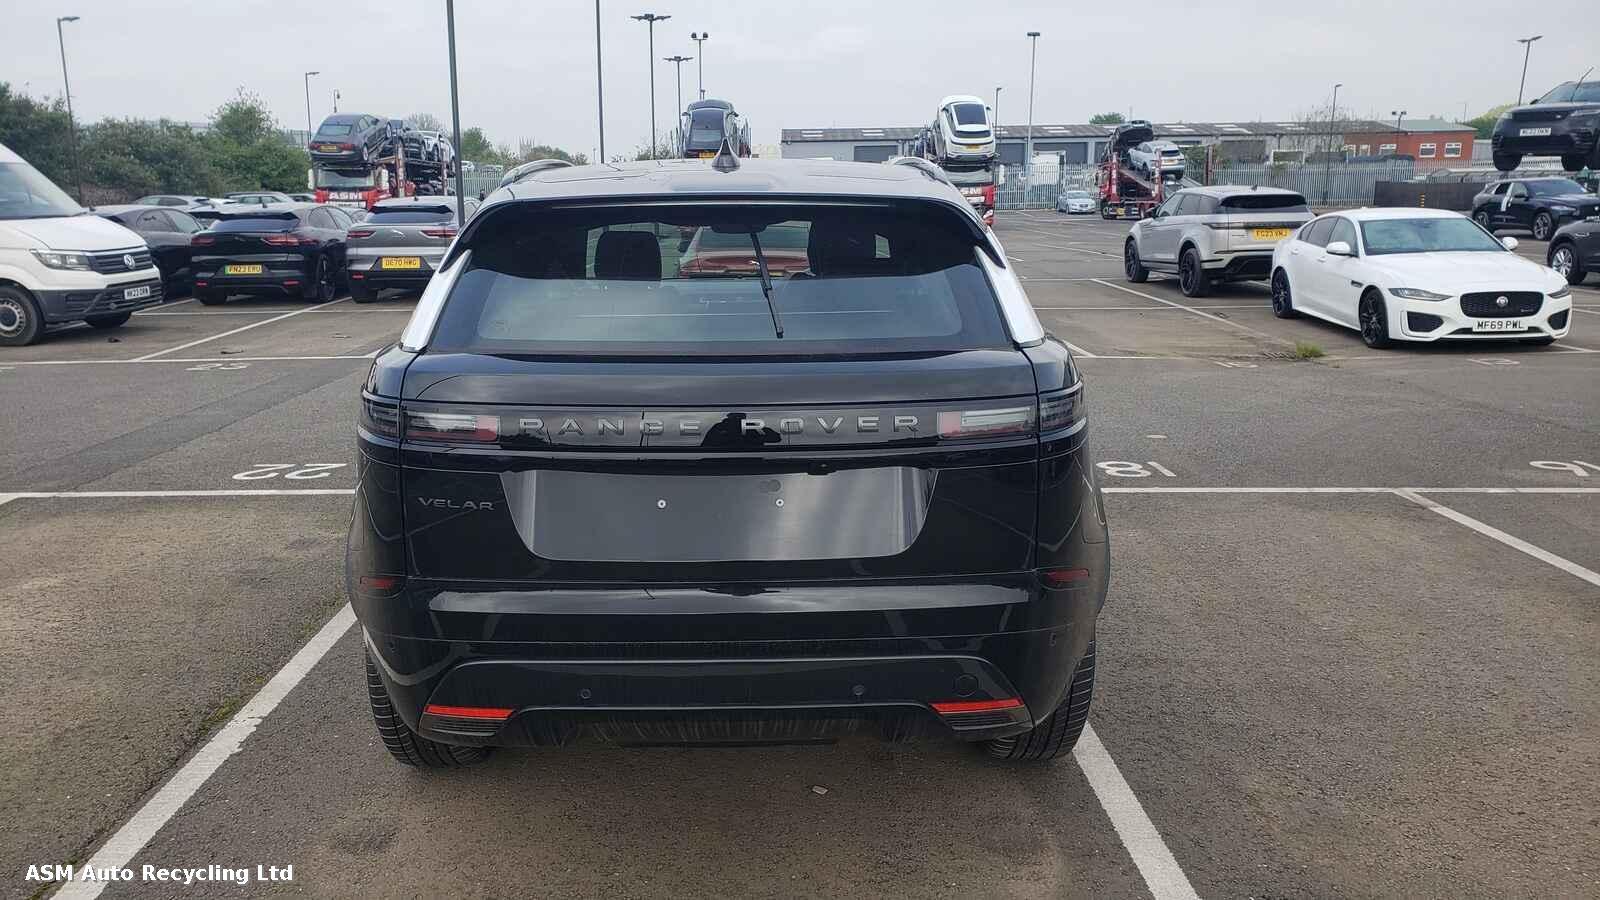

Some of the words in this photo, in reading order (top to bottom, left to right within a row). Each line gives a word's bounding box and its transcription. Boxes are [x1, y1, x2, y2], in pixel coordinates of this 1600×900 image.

[329, 192, 363, 200] ASM
[1477, 320, 1503, 329] MF69
[1506, 320, 1524, 329] PWL
[519, 417, 702, 436] RANGE
[741, 415, 921, 435] ROVER
[232, 463, 347, 480] 22
[1096, 461, 1177, 477] 18
[418, 496, 494, 511] VELAR
